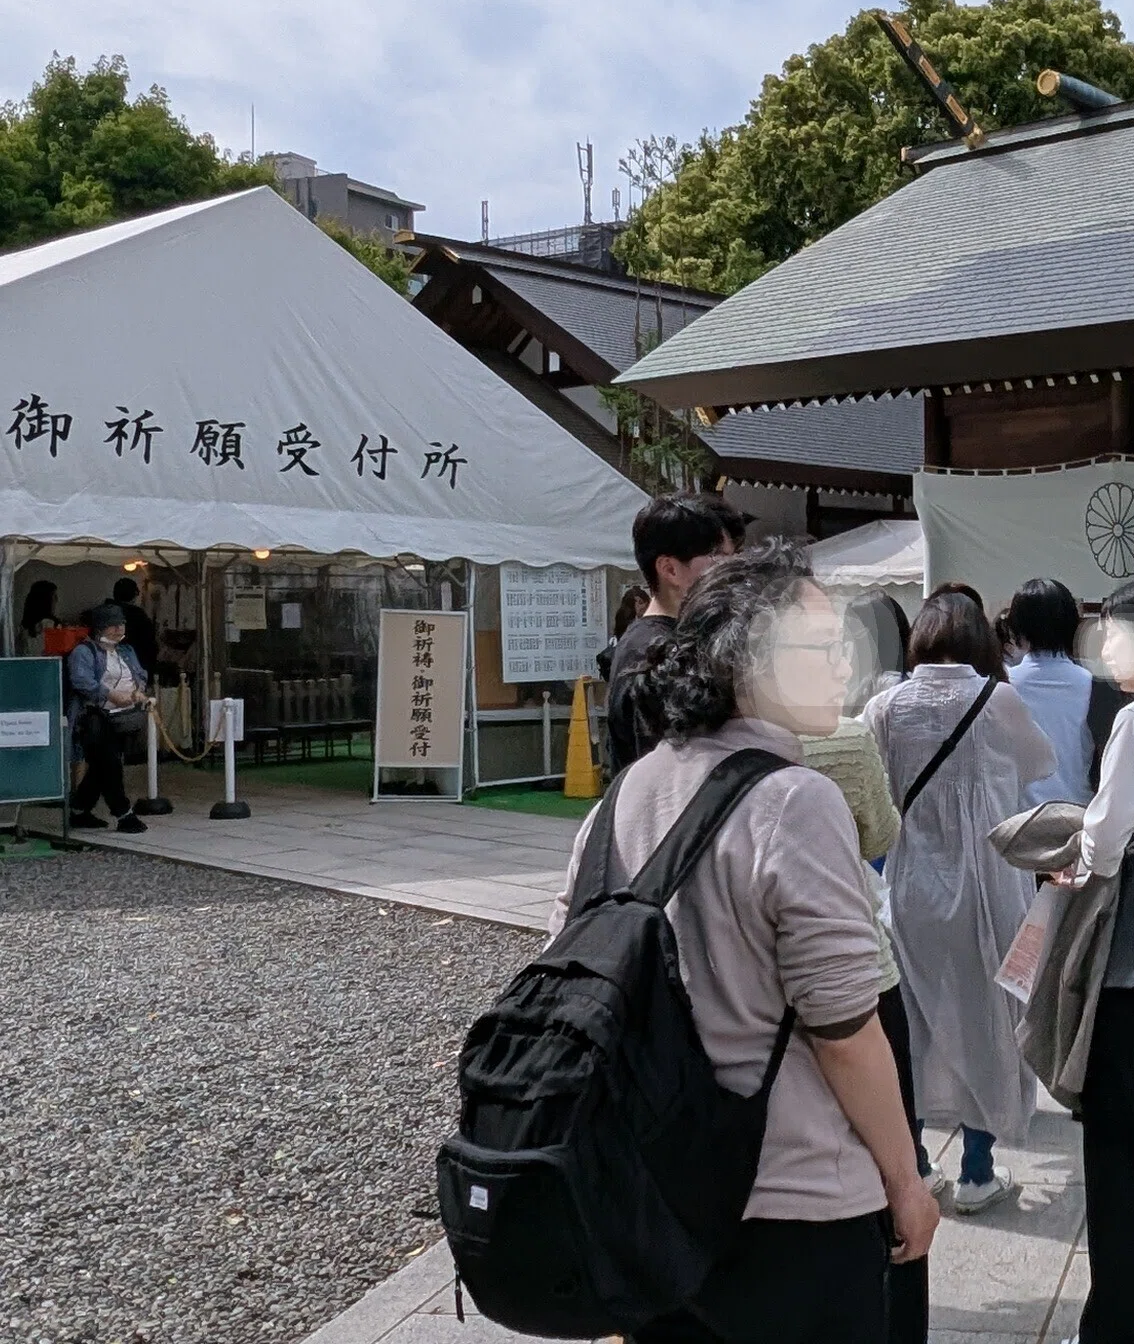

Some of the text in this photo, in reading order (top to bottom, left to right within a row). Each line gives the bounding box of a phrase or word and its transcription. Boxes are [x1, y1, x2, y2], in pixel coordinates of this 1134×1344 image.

[5, 393, 468, 490] 御祈願受付所
